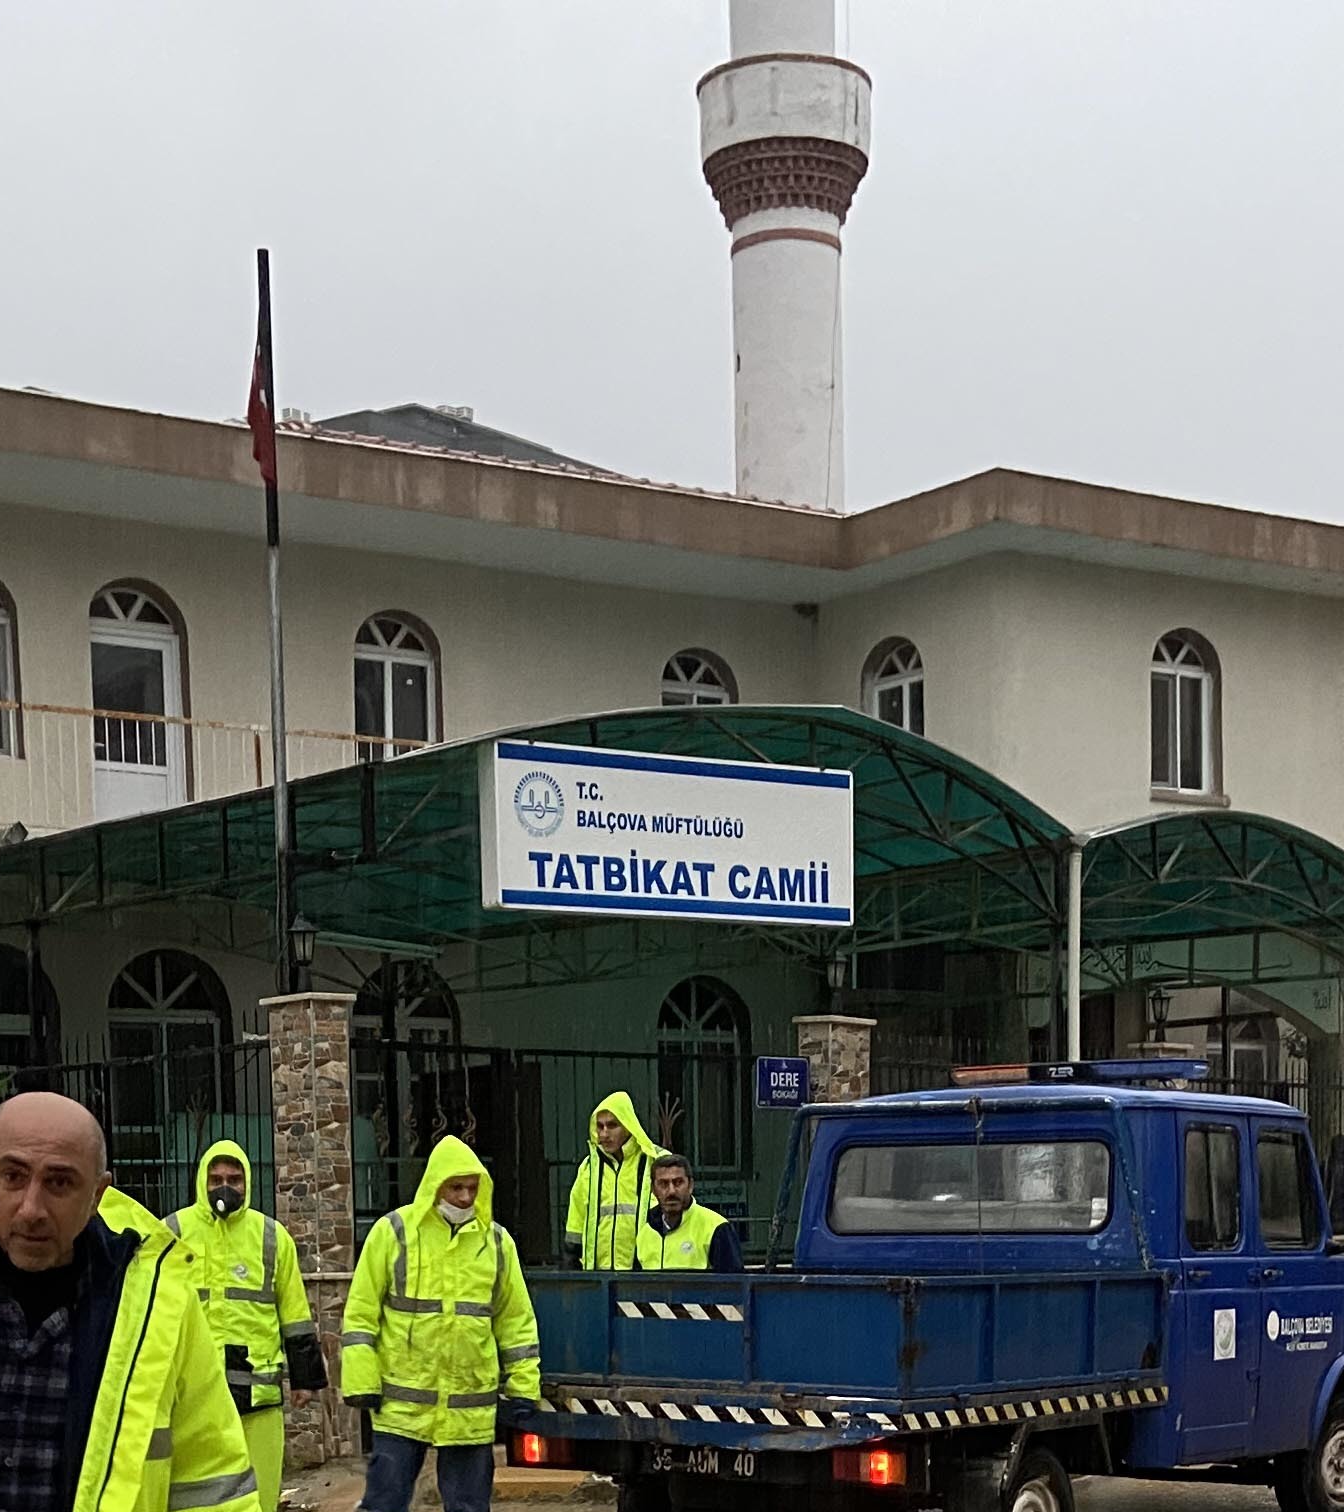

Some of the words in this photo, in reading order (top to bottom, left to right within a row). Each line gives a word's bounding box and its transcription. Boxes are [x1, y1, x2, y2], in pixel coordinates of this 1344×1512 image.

[576, 782, 604, 802] T.C.
[576, 810, 647, 834] BALÇOVA
[652, 812, 744, 839] MÜFTÜLÜĞÜ
[528, 849, 715, 897] TATBİKAT
[728, 860, 830, 904] CAMİİ
[770, 1071, 800, 1088] DERE
[734, 1453, 755, 1477] 40
